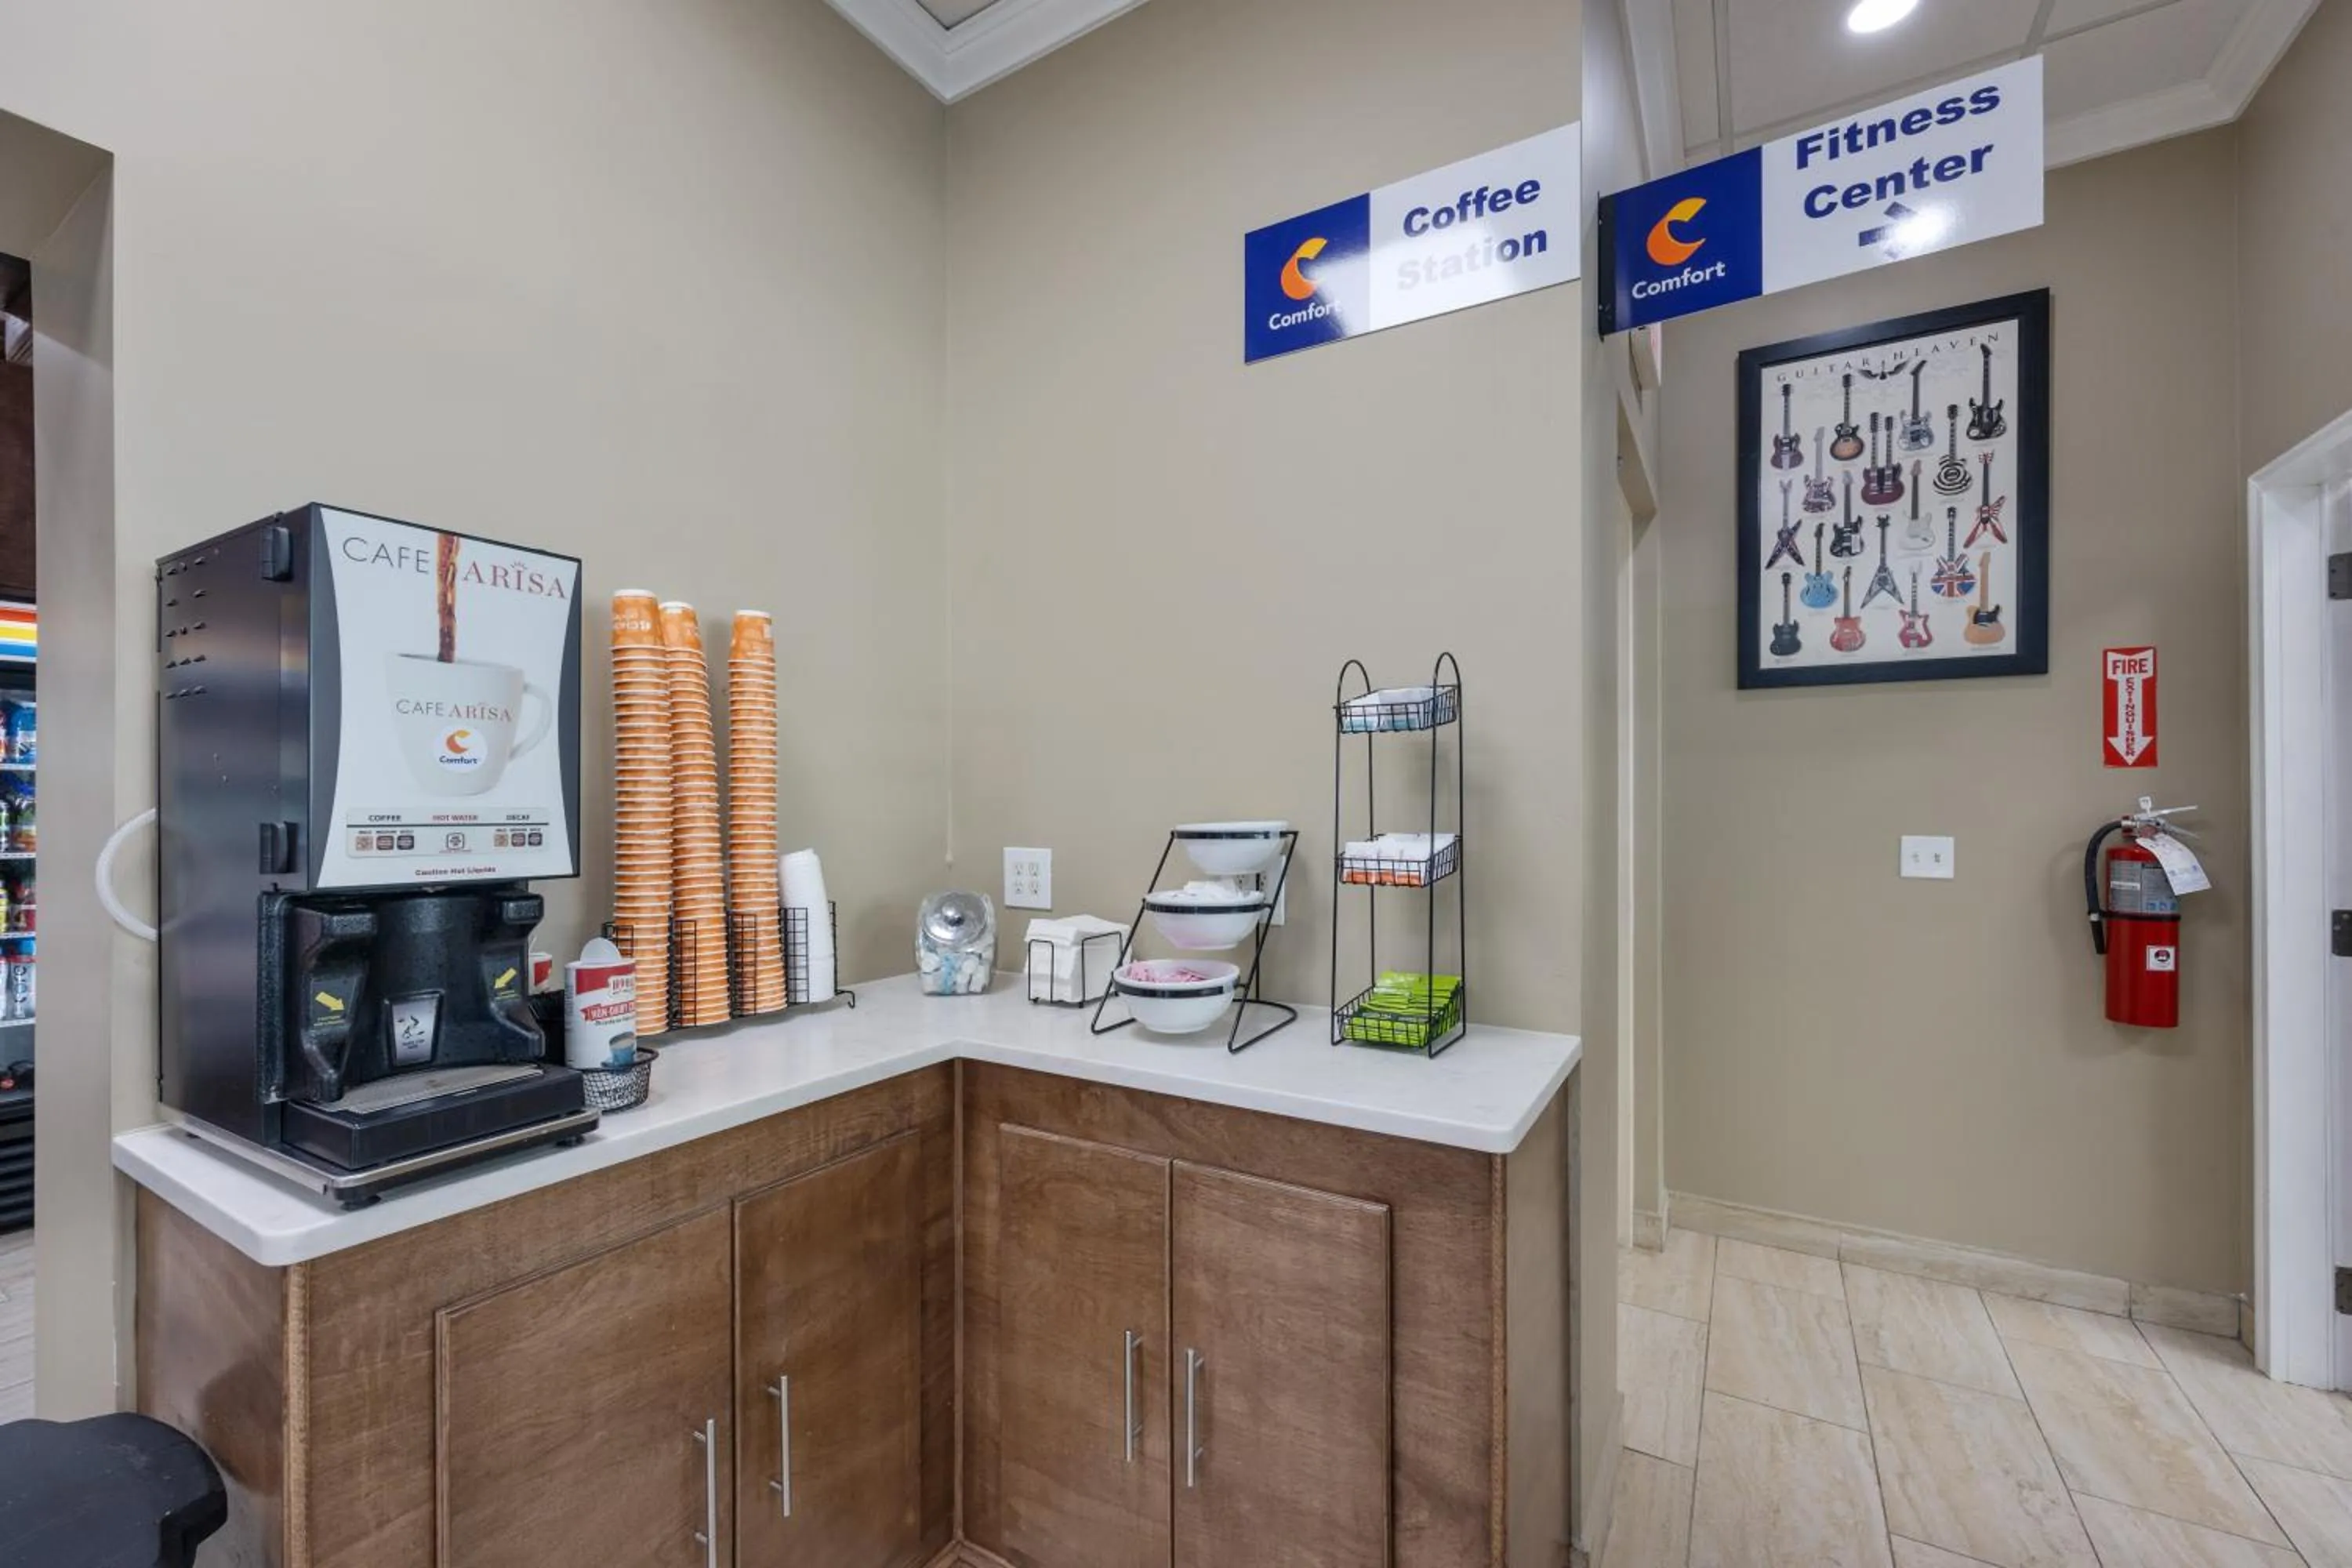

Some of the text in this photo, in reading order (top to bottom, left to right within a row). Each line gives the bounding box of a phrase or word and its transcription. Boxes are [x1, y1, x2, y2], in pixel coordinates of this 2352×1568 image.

[1796, 84, 2002, 170] Fitness
[1803, 143, 1995, 220] Center
[1403, 178, 1541, 238] Coffee
[1397, 229, 1548, 291] Station
[1632, 260, 1726, 299] Comfort
[1269, 300, 1342, 330] Comfort
[342, 536, 431, 575] CAFE
[2111, 658, 2149, 675] FIRE
[395, 699, 445, 717] CAFE
[438, 755, 478, 764] Comfort
